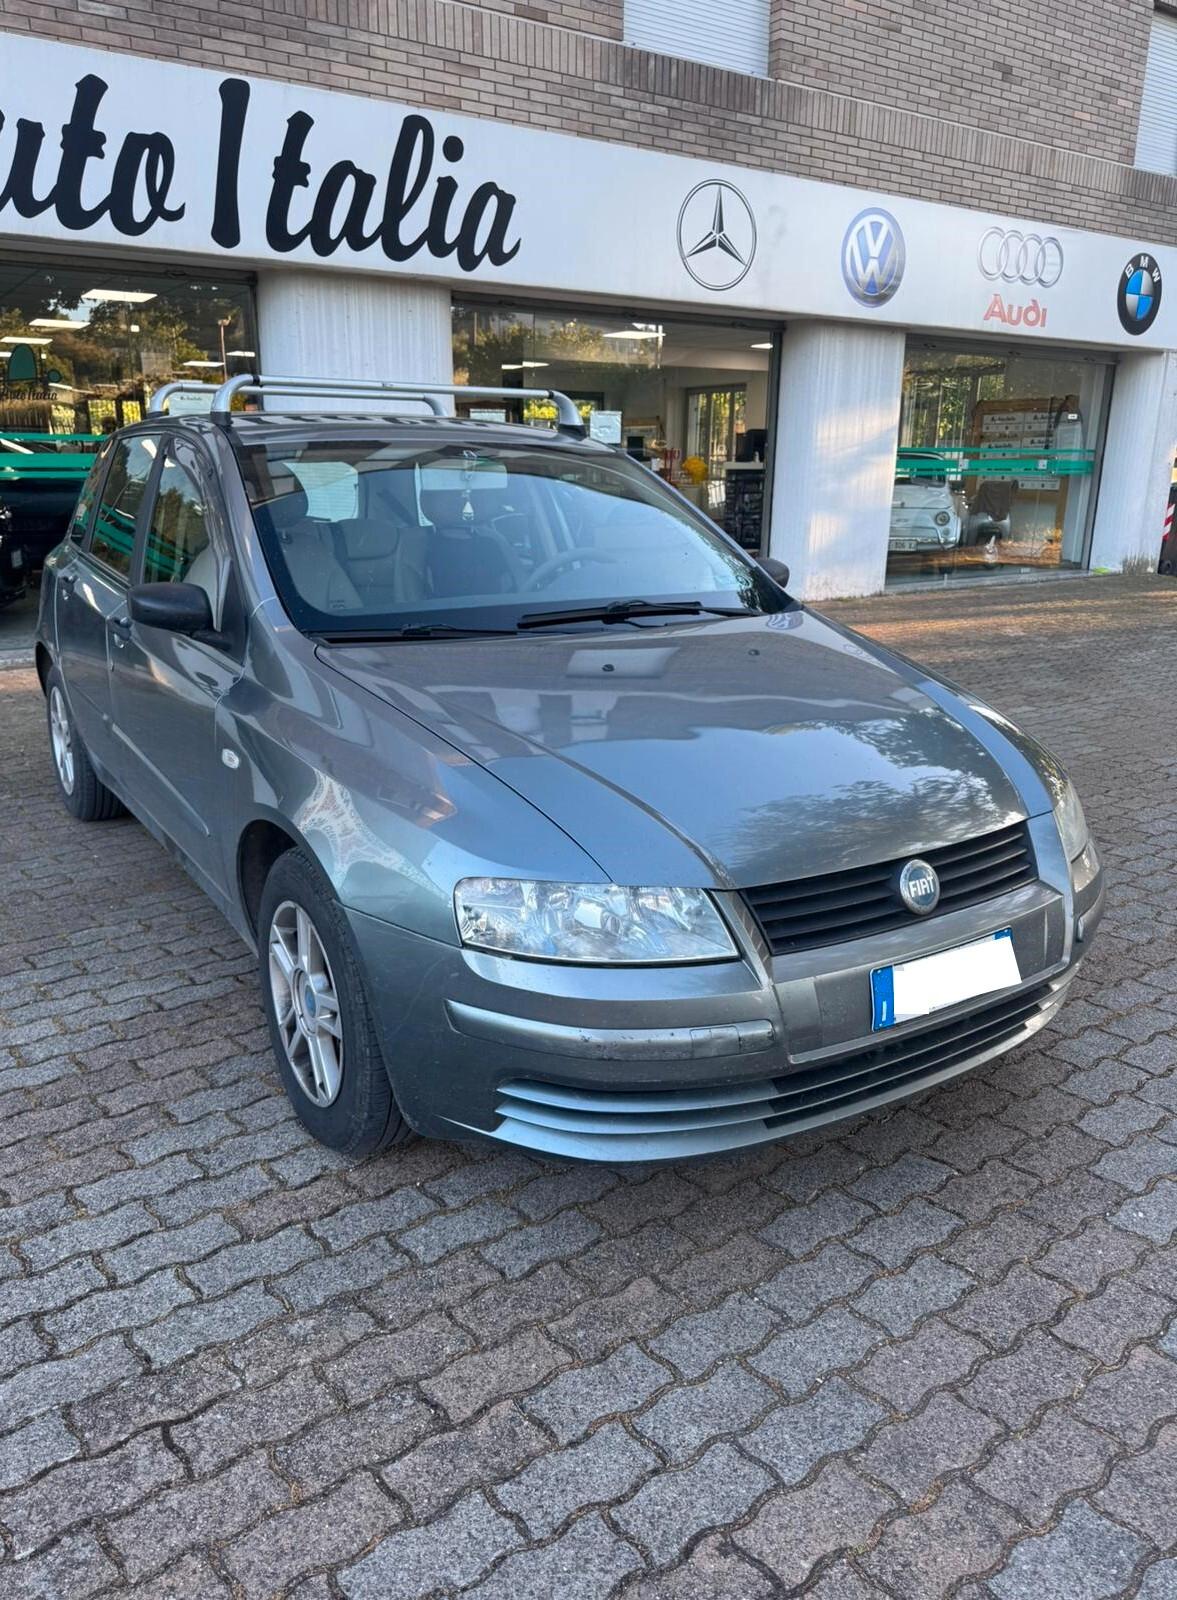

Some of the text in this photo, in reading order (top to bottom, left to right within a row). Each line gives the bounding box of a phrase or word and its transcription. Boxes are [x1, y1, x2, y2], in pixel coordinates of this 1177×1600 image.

[0, 74, 521, 272] uto Italia
[1125, 255, 1161, 283] BMW
[983, 293, 1048, 328] Audi
[908, 875, 934, 898] FIAT
